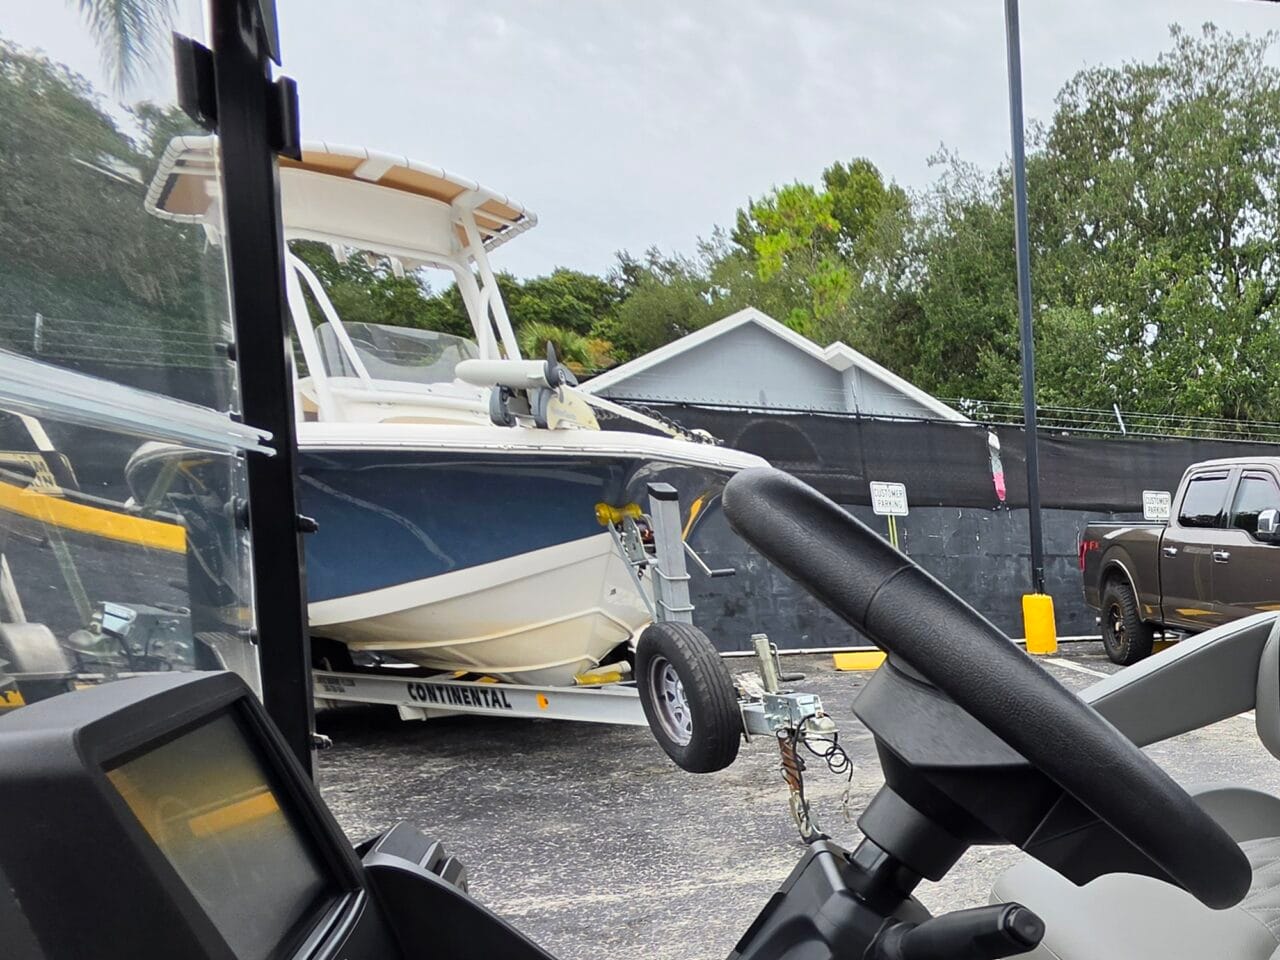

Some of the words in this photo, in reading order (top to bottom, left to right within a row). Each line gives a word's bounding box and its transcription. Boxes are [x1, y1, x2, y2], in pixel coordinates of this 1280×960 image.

[873, 488, 903, 498] CUSTOMER
[877, 499, 903, 509] PARKING
[1146, 497, 1169, 505] CUSTOMER
[1148, 506, 1168, 514] PARKING
[407, 683, 512, 709] CONTINENTAL
